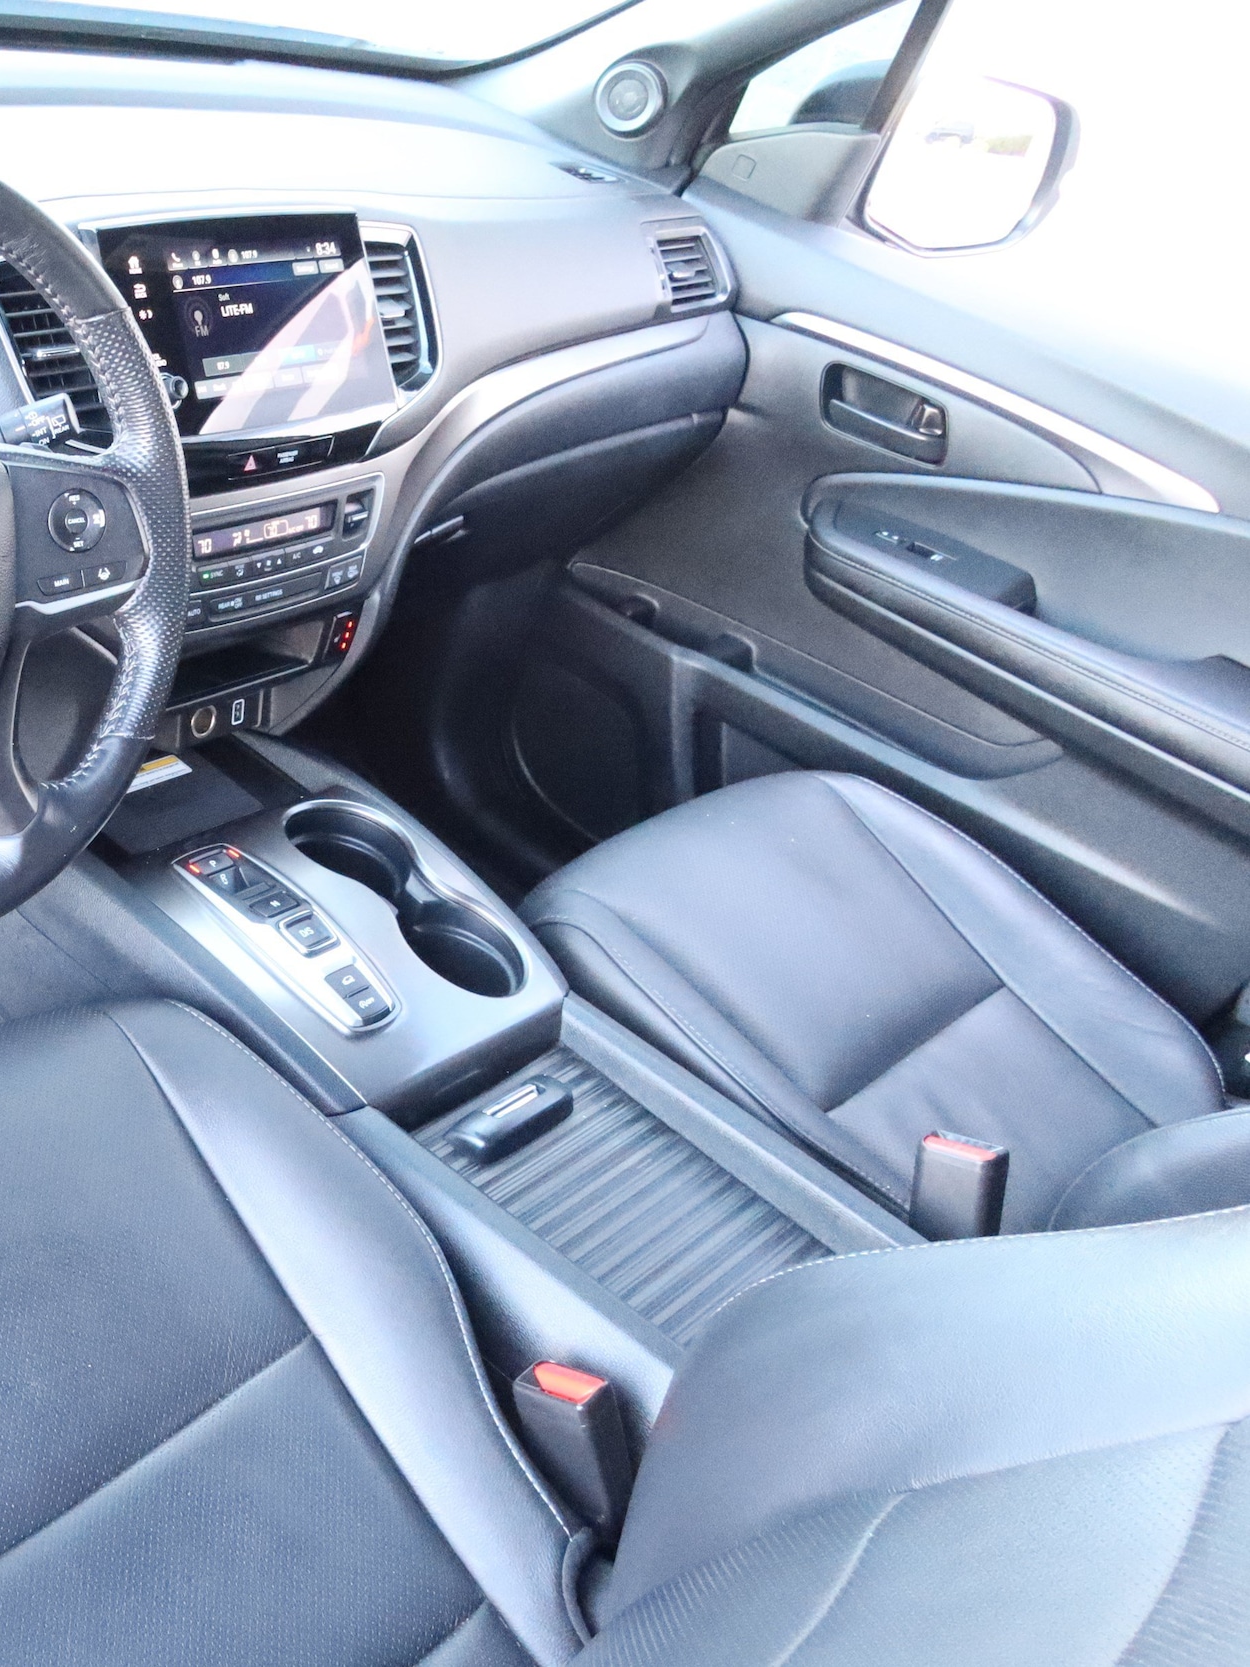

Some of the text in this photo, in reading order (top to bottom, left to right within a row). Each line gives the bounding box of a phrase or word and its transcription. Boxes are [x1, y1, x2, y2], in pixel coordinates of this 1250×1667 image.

[315, 242, 336, 255] 8:34
[192, 275, 212, 285] 107.9
[220, 303, 254, 318] LITE-FM
[195, 325, 210, 337] FM
[305, 515, 318, 529] 70
[198, 538, 213, 554] 70
[54, 578, 70, 587] MAIN
[209, 860, 217, 868] P
[270, 900, 281, 908] N
